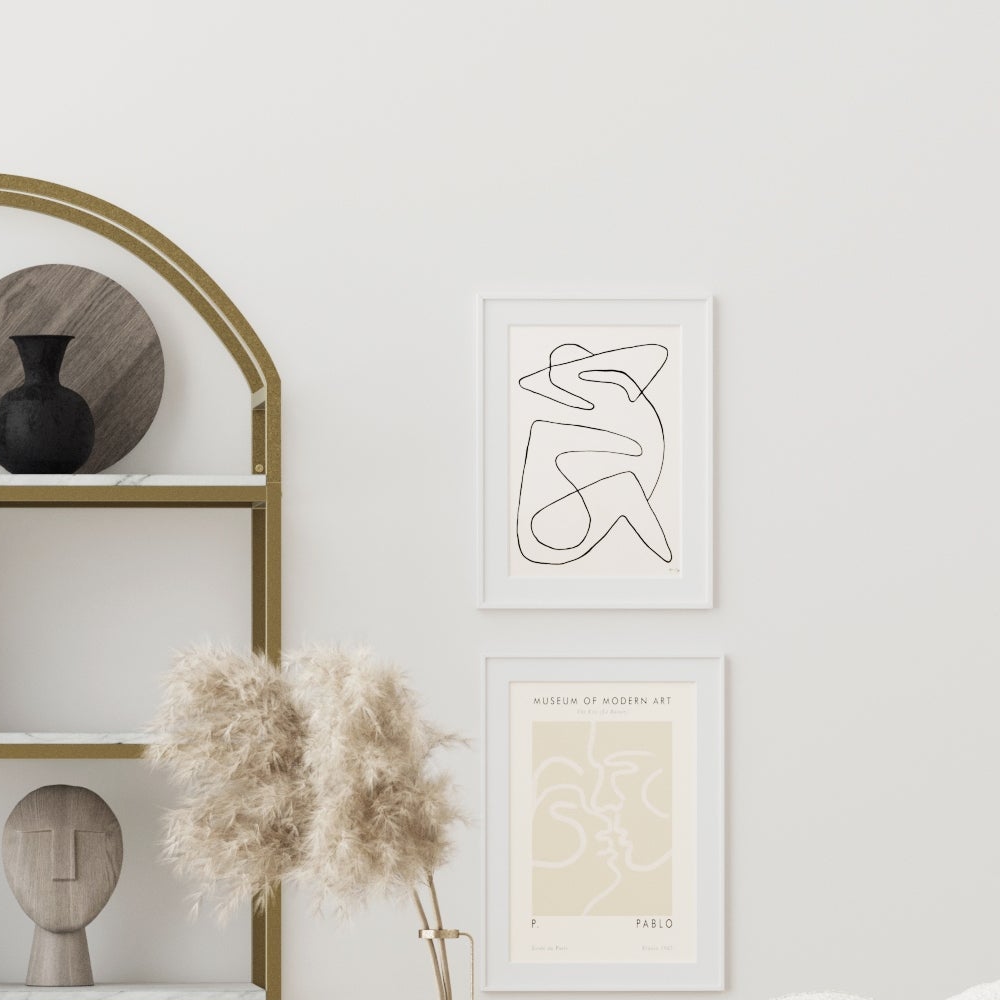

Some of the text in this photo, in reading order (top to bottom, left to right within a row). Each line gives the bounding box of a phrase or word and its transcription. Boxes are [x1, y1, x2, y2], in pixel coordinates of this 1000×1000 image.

[533, 696, 671, 705] MUSEUM OF MODERN ART
[636, 918, 673, 928] PABLO
